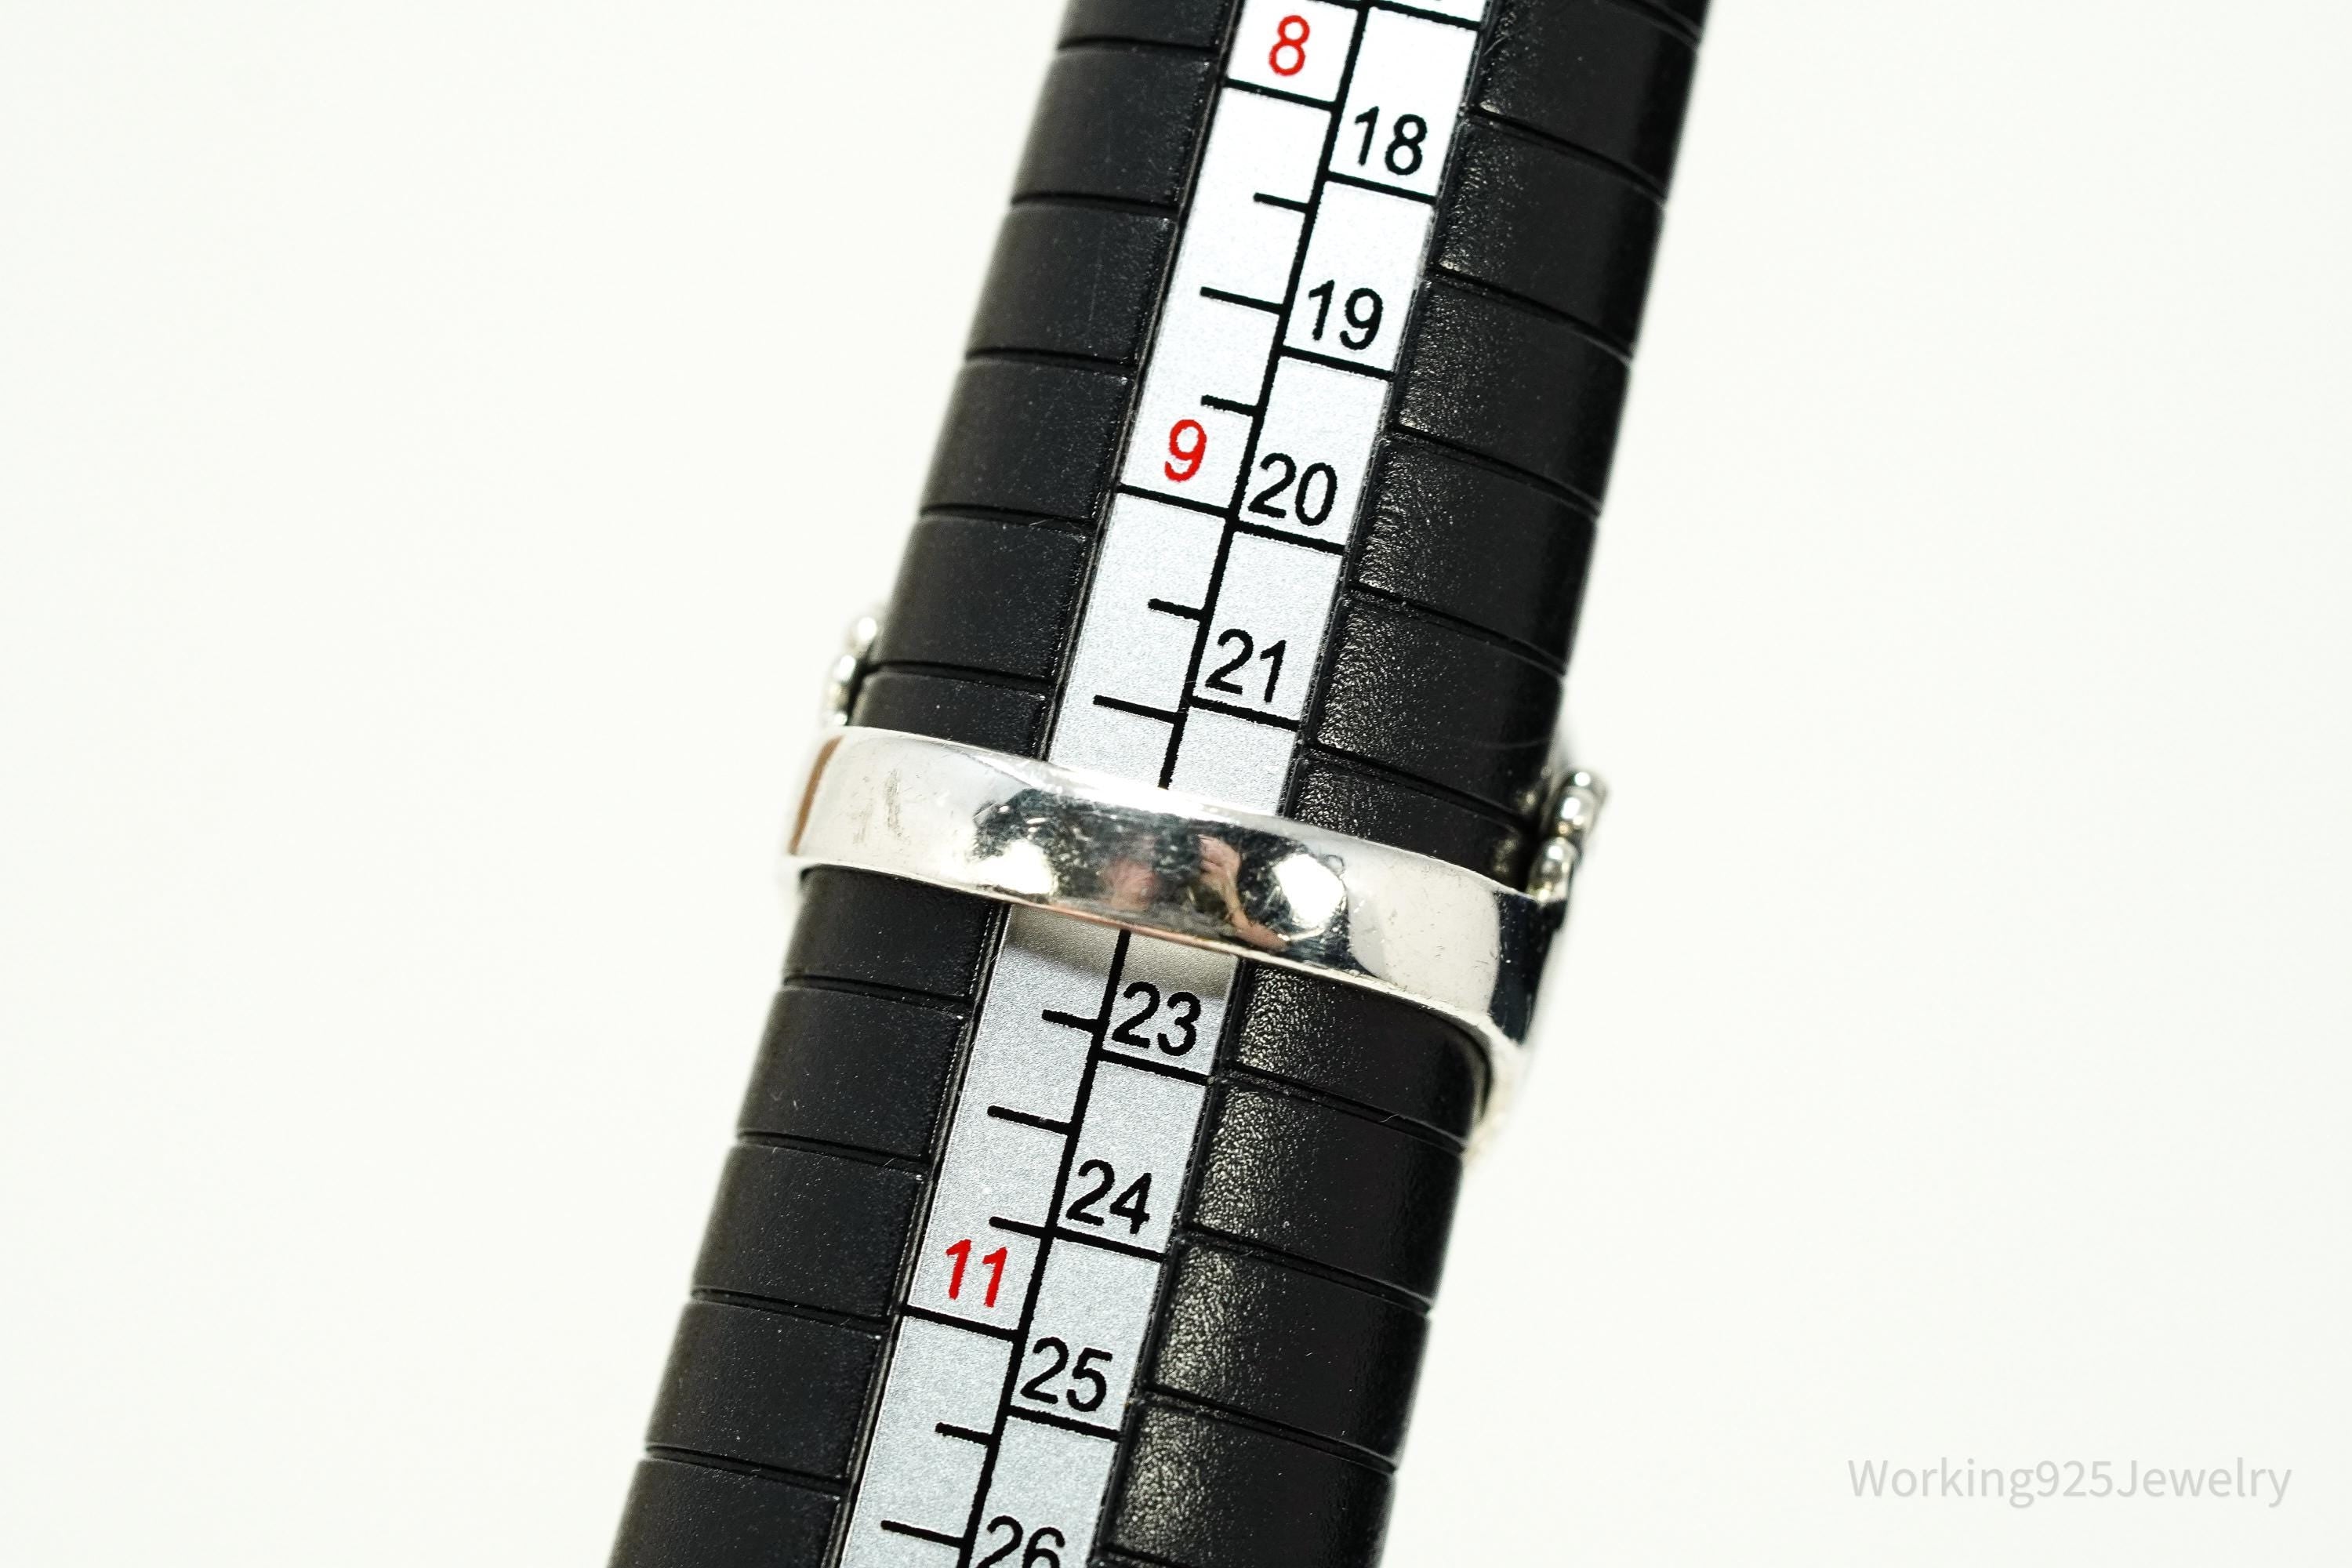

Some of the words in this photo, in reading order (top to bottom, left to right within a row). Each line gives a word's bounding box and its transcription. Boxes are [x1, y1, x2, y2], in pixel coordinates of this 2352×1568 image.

[1269, 15, 1310, 77] 8
[1354, 106, 1428, 176] 18
[1308, 279, 1384, 351] 19
[1164, 419, 1207, 482] 9
[1247, 452, 1338, 527] 20
[1204, 628, 1287, 703] 21
[1110, 981, 1203, 1057] 23
[1065, 1159, 1152, 1235] 24
[946, 1239, 1007, 1308] 11
[1019, 1336, 1113, 1413] 25
